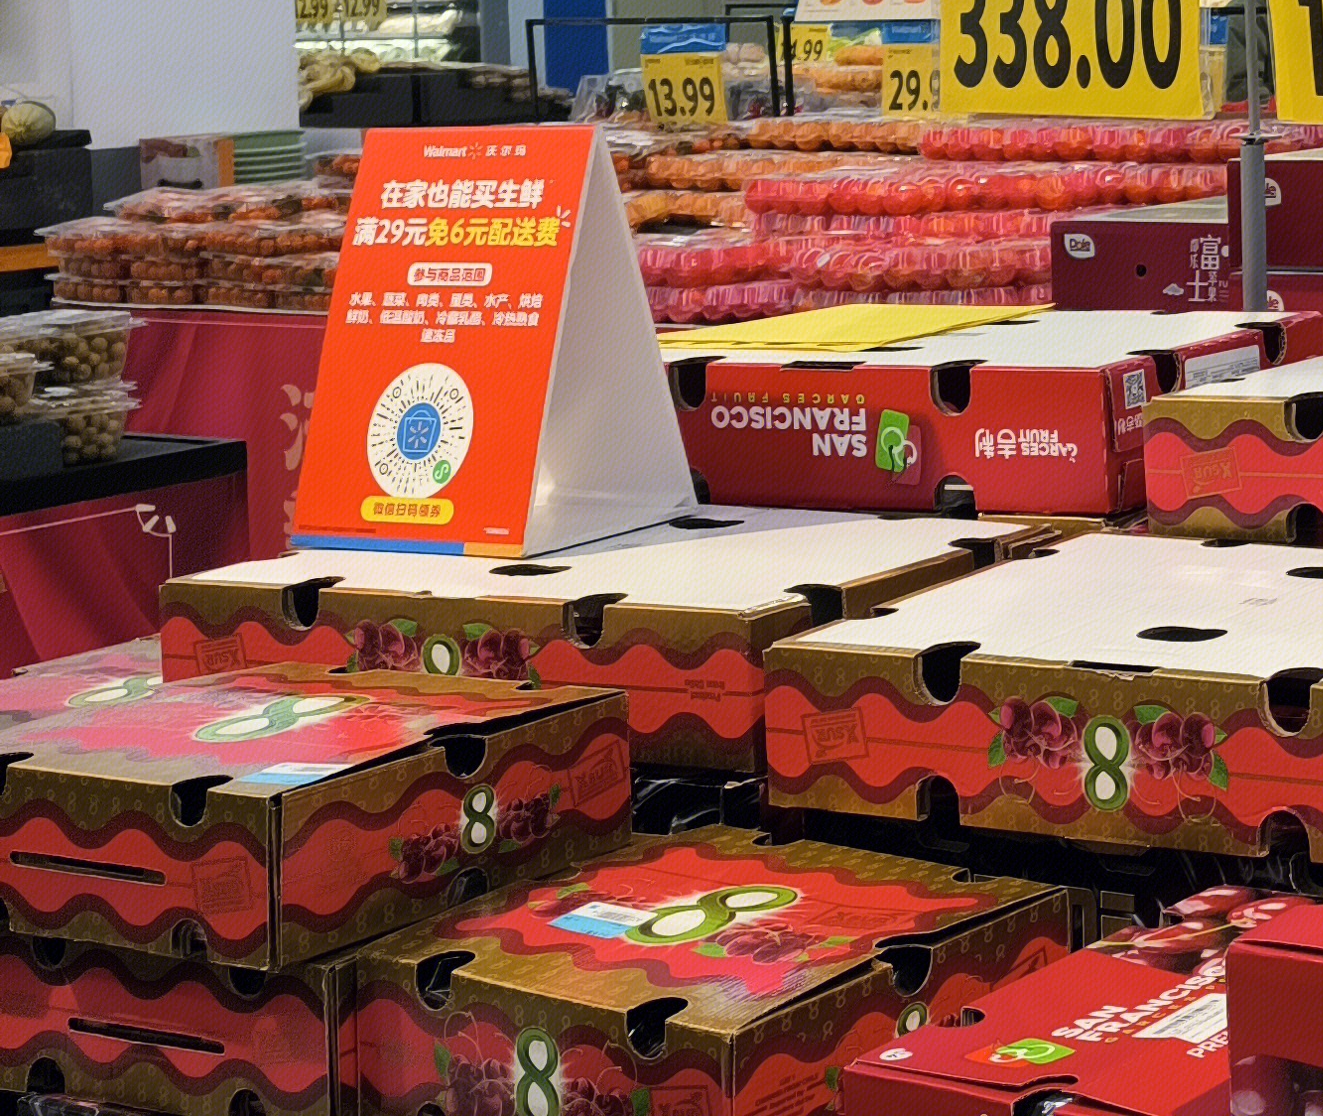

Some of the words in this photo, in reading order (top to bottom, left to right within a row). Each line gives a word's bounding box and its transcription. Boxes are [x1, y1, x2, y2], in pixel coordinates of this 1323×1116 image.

[649, 77, 716, 118] 13.99
[423, 143, 467, 158] Walmart
[380, 179, 545, 210] 在家也能买生鲜
[352, 216, 560, 247] 满29元免6元配送费
[711, 407, 867, 431] FRANCISCO
[811, 433, 867, 457] SAN
[1019, 429, 1060, 443] FRUIT
[1020, 442, 1078, 462] GARCES
[1082, 713, 1132, 814] 8
[1051, 1005, 1126, 1039] SAN
